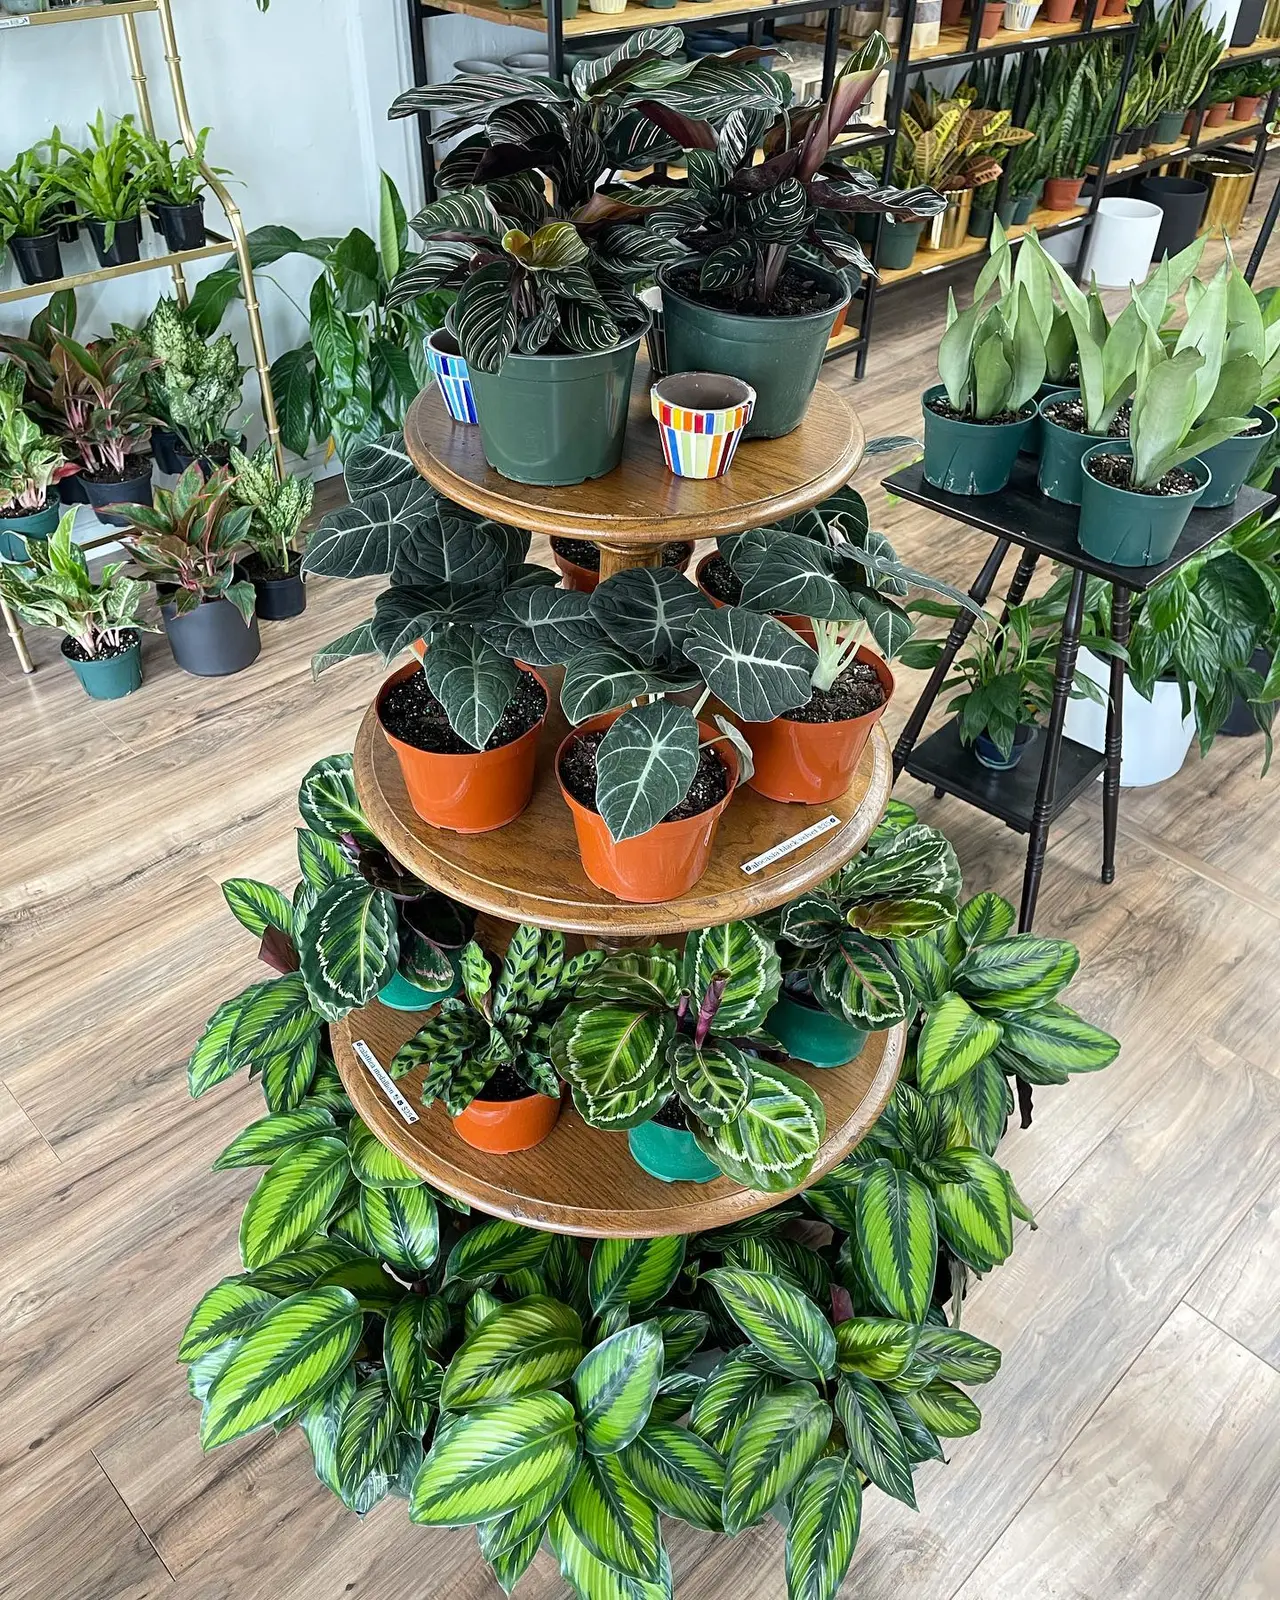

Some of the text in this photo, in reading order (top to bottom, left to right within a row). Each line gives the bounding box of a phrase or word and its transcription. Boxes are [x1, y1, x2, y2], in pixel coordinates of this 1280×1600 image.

[752, 850, 780, 869] alocasia
[780, 839, 800, 853] black
[799, 829, 819, 842] velvet
[358, 1046, 376, 1069] calathea
[373, 1068, 394, 1095] medallion
